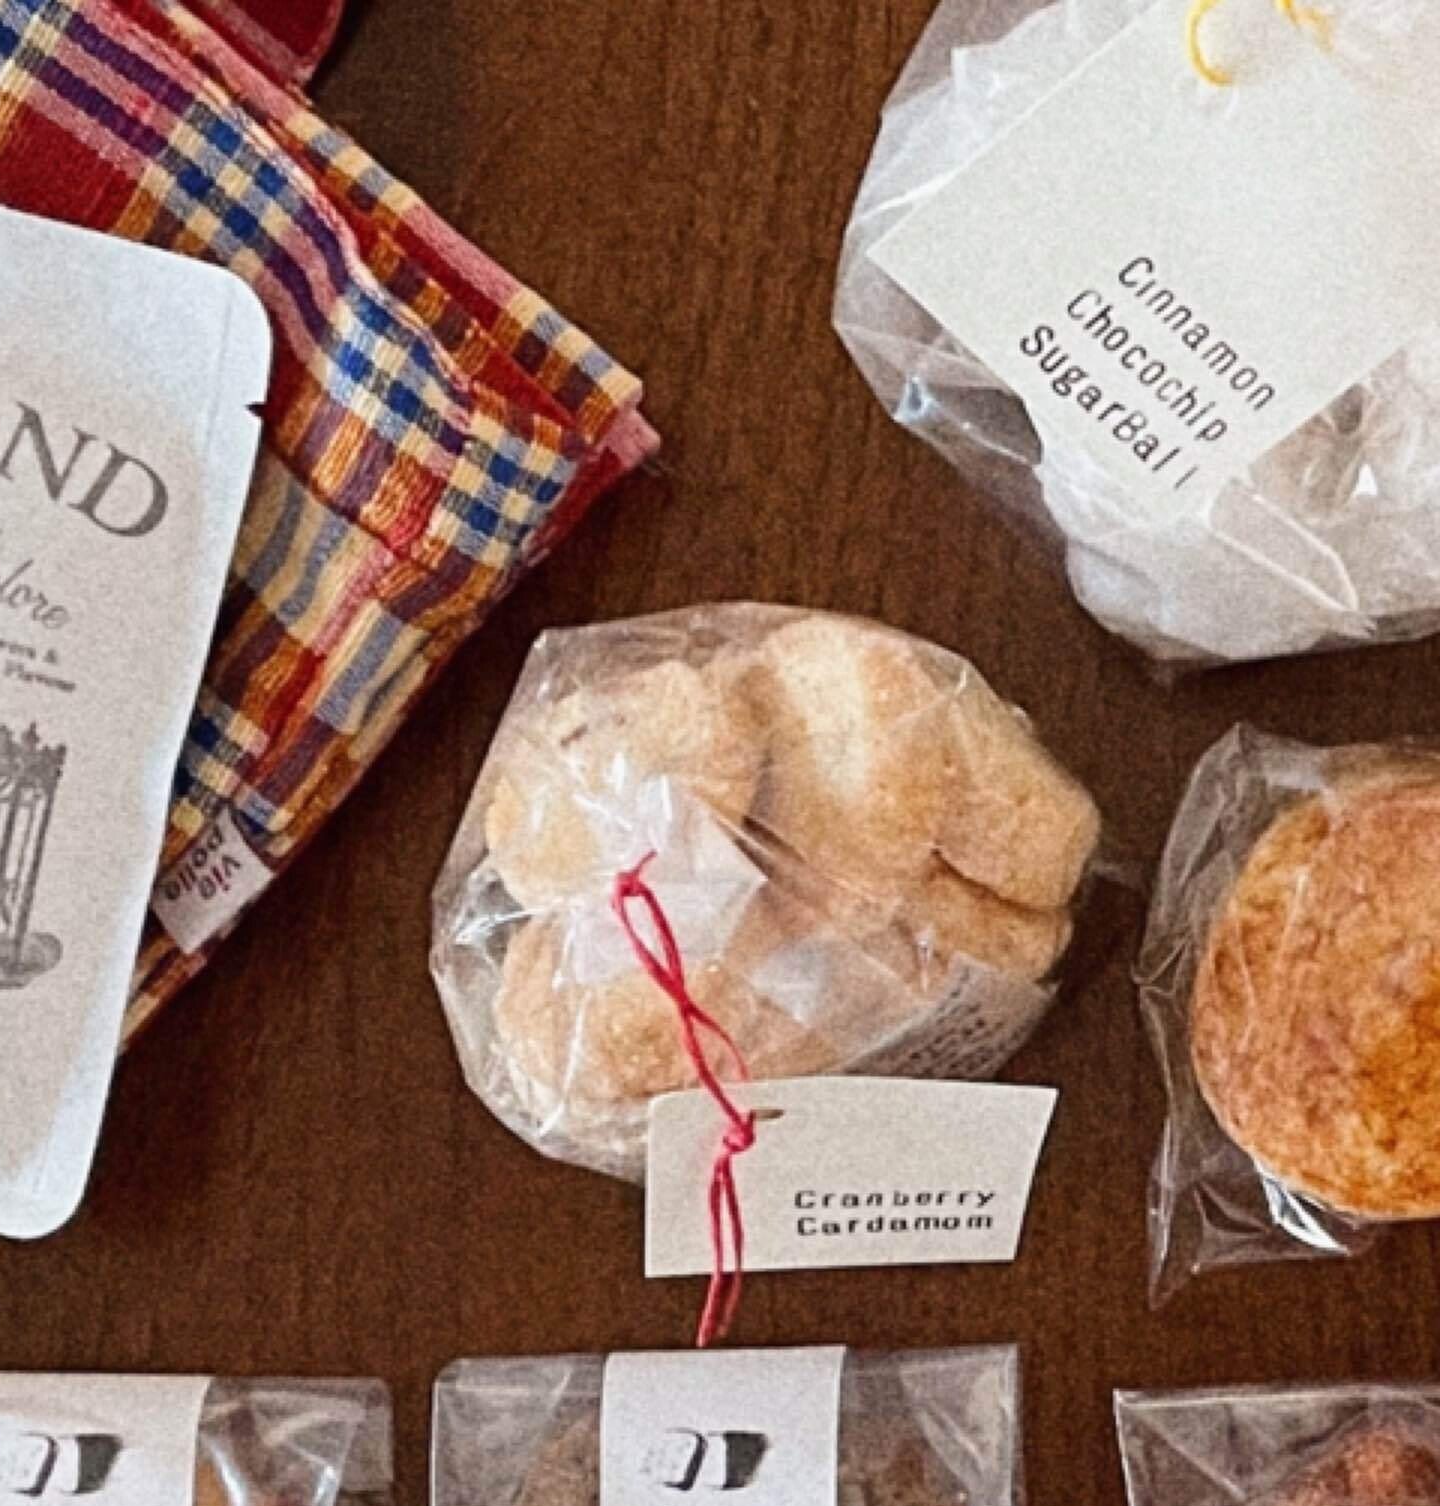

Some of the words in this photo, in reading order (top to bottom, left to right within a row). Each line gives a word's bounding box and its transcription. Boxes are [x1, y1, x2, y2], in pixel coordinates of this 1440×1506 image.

[1019, 324, 1199, 490] SugarBall
[1066, 288, 1228, 442] Chocochip
[1118, 256, 1276, 411] Cinnamon
[794, 1189, 997, 1210] Cranberry
[796, 1214, 994, 1237] Cardamom
